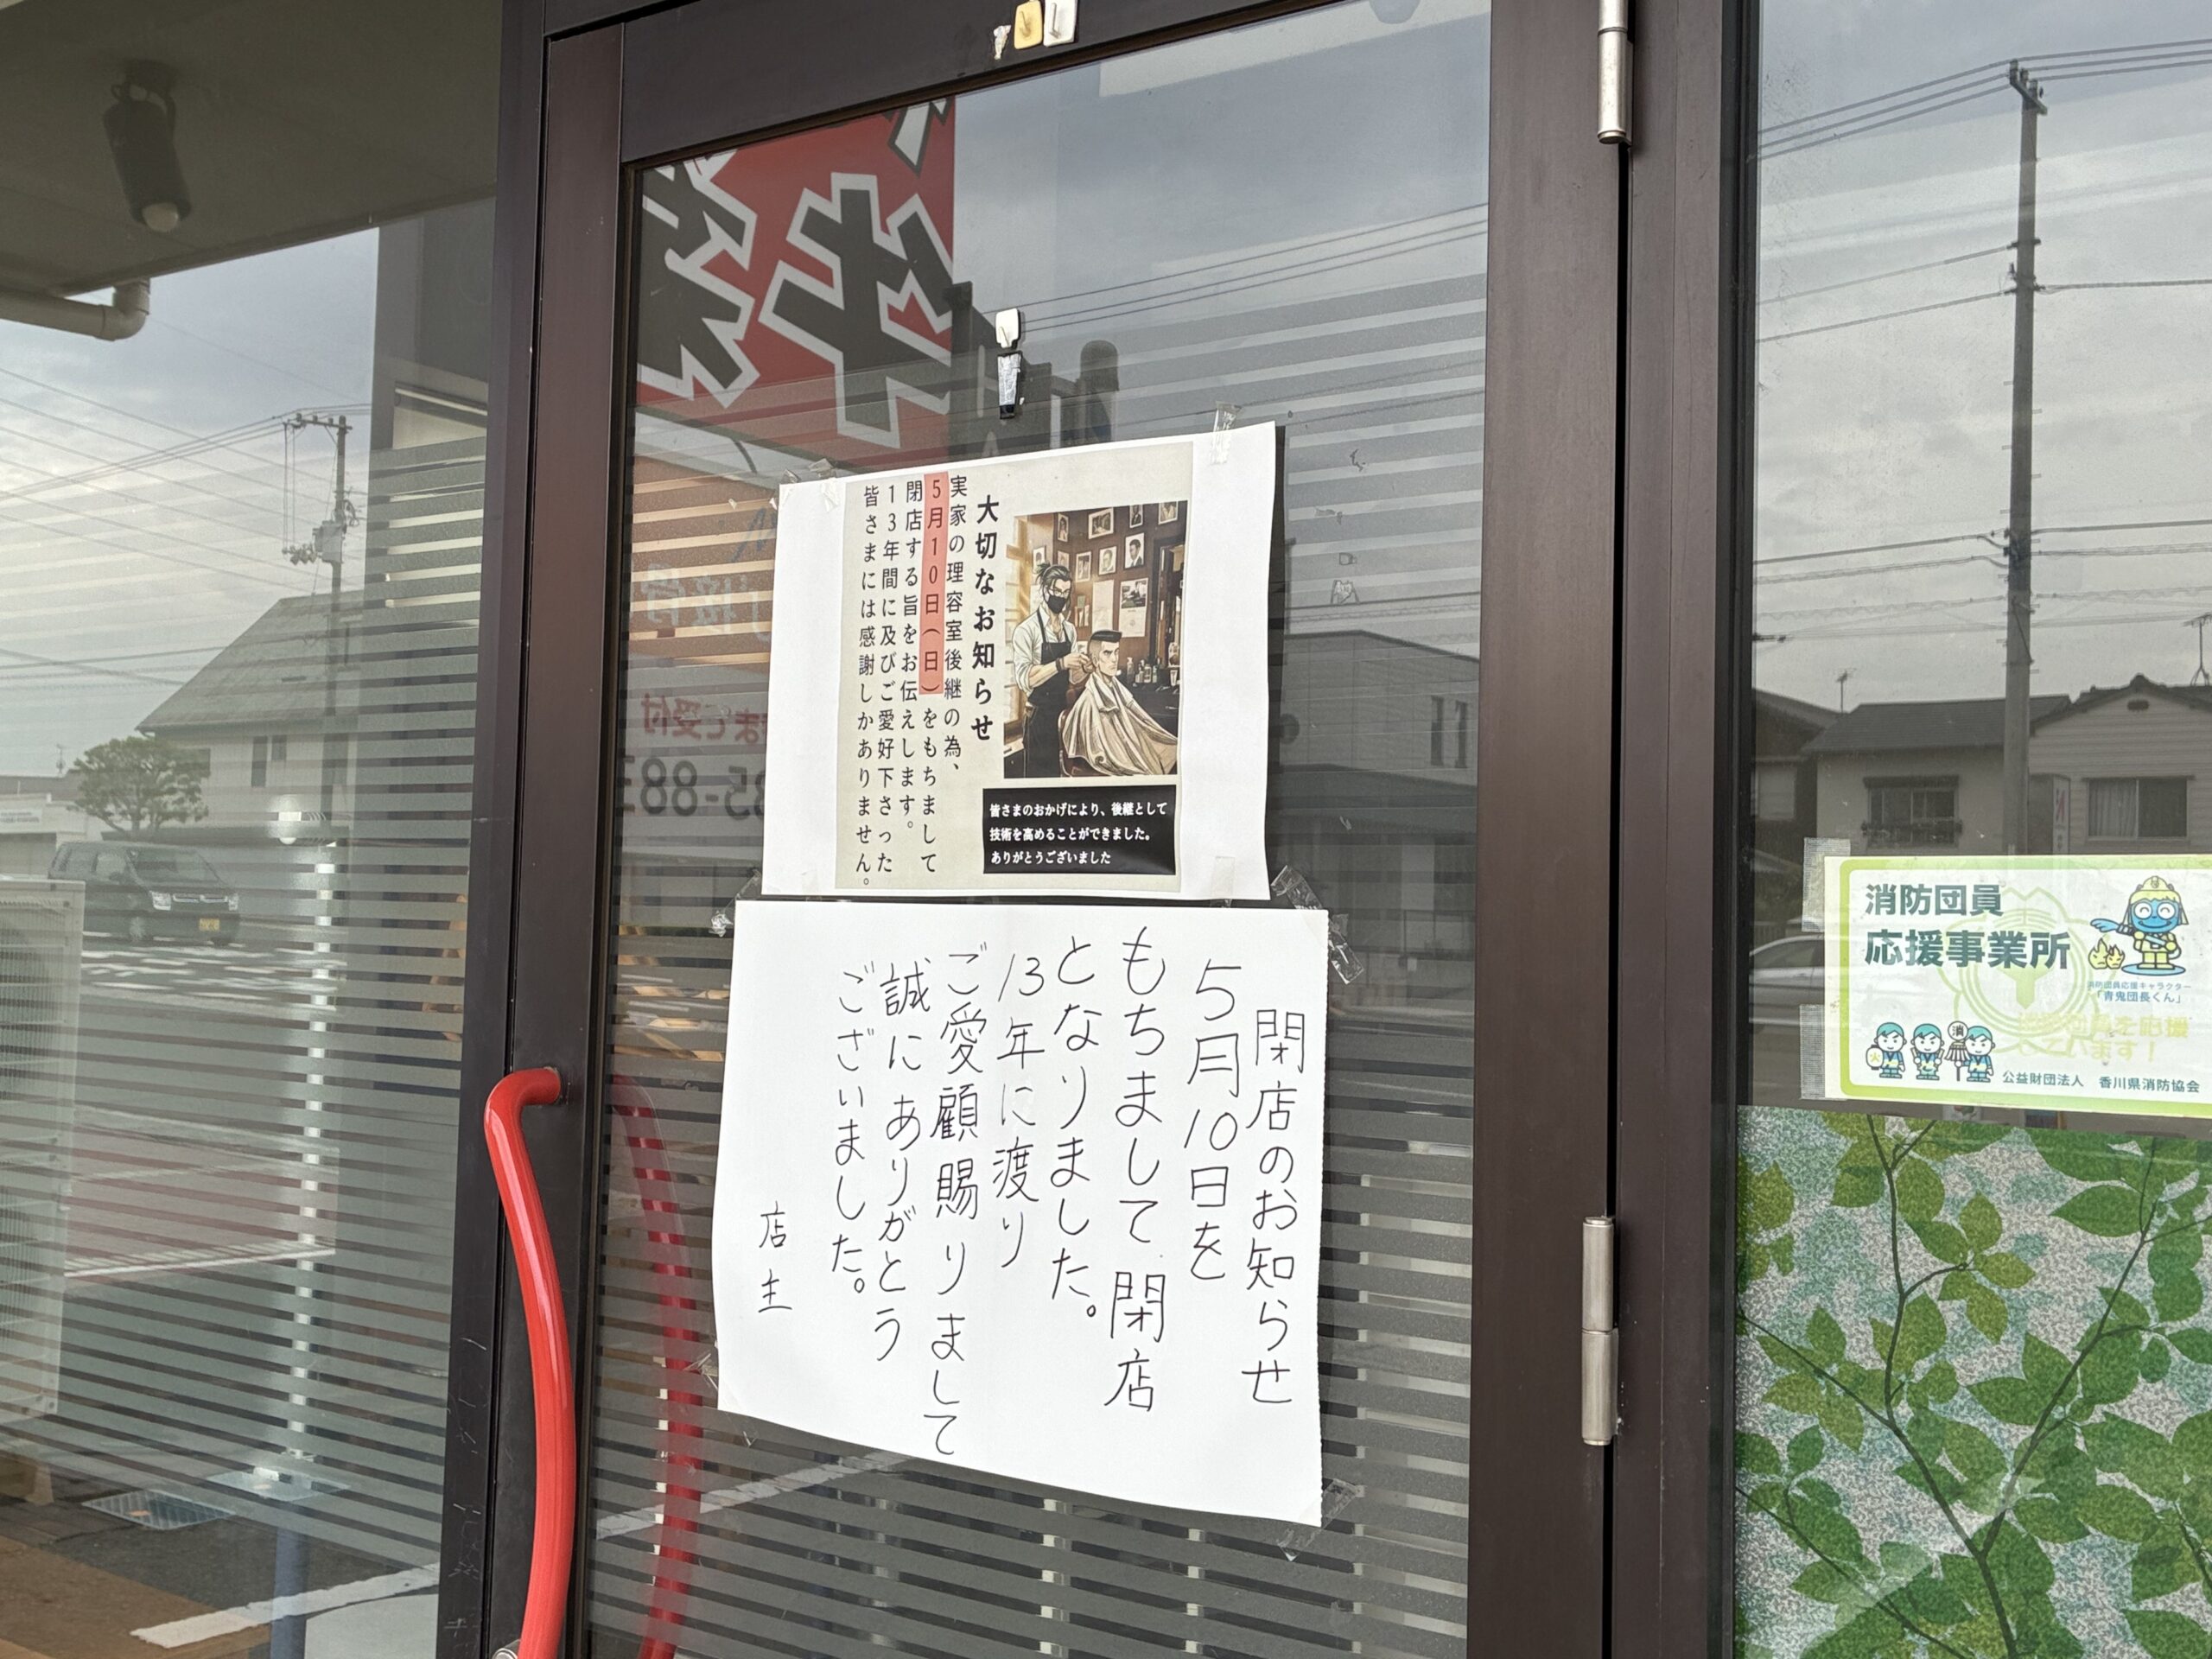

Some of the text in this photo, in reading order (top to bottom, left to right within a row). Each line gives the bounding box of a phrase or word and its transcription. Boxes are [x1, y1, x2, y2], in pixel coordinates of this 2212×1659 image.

[855, 485, 880, 886] 皆さまには感謝しかありません。
[877, 485, 899, 873] 13年間に及びご愛好下さった
[899, 480, 923, 829] 閉店する旨をお伝えします。
[944, 474, 968, 770] 実家の理容室後継の為、
[970, 494, 1000, 741] 大切なお知らせ
[989, 802, 1168, 818] 皆さまのおかげにより、後継として
[989, 827, 1151, 842] 技術を高めることができました。
[990, 850, 1112, 865] ありがとうございました
[1865, 883, 2004, 917] 消防団員
[1865, 929, 2071, 969] 応援事業所
[831, 961, 875, 1294] ございました。
[874, 957, 931, 1362] 誠にありがとう
[992, 952, 1045, 1268] 13年に渡り
[1051, 936, 1103, 1318] となりました。
[1184, 959, 1242, 1281] 5月10日を
[1952, 1024, 1965, 1037] 消
[2002, 1071, 2201, 1094] 公益財団法人 香川県消防協会
[758, 1200, 793, 1313] 店主
[923, 941, 988, 1456] ご愛顧賜りまして
[1241, 1009, 1306, 1404] 閉店のお知らせ
